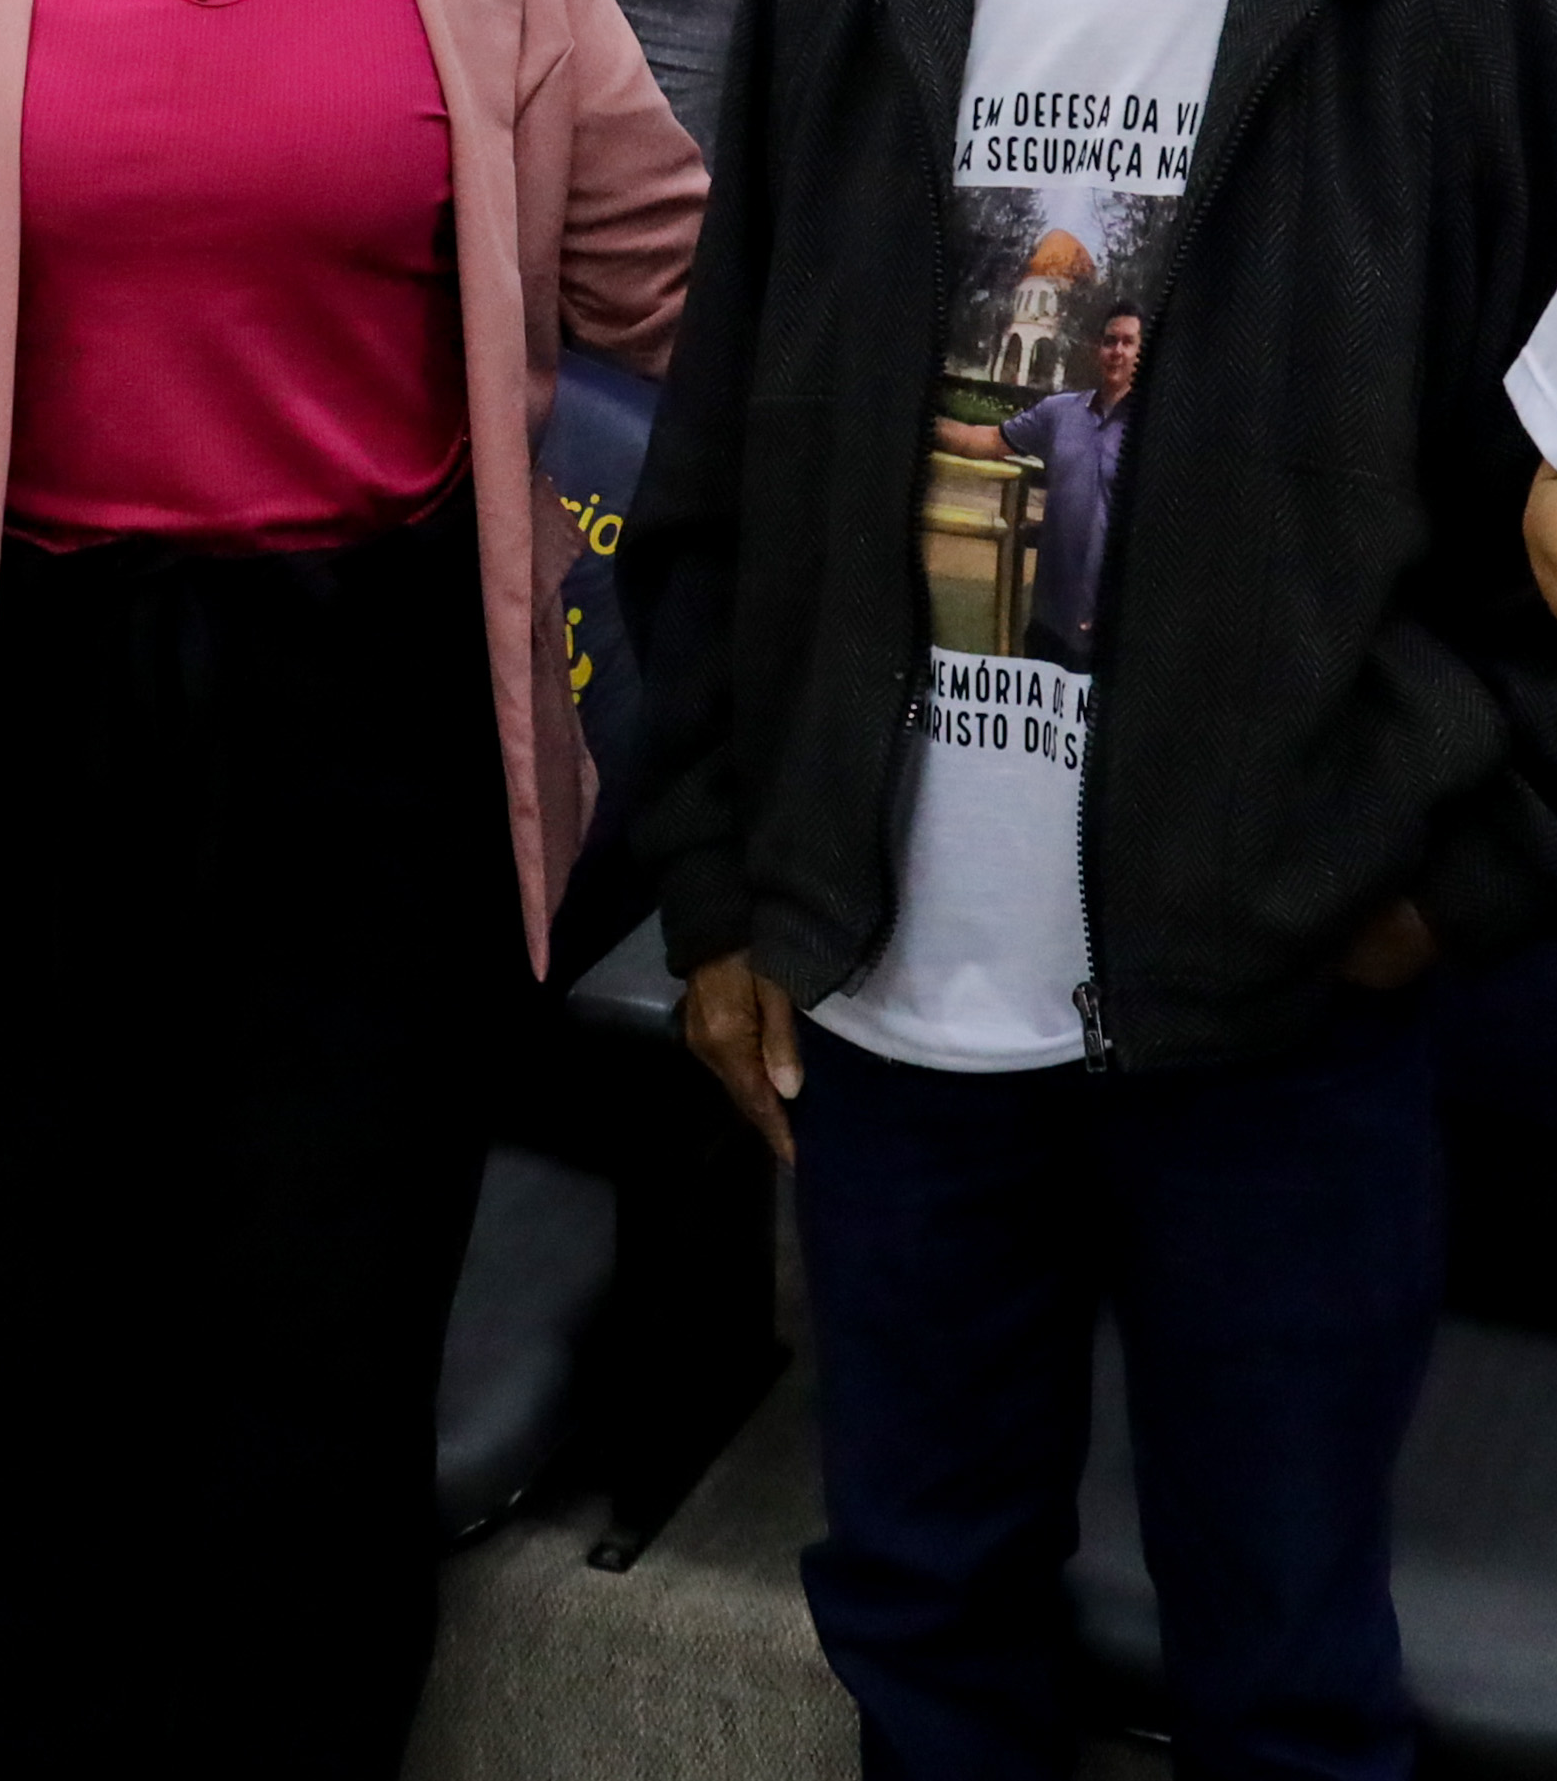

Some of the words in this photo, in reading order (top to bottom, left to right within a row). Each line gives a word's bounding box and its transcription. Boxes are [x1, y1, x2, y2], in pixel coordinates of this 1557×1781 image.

[972, 96, 1004, 131] EM
[1014, 92, 1110, 129] DEFESA
[1122, 94, 1158, 134] DA
[987, 136, 1142, 182] SEGURANÇA
[1157, 145, 1188, 180] NA
[936, 659, 1043, 709] EMÓRIA
[1025, 717, 1058, 763] DOS
